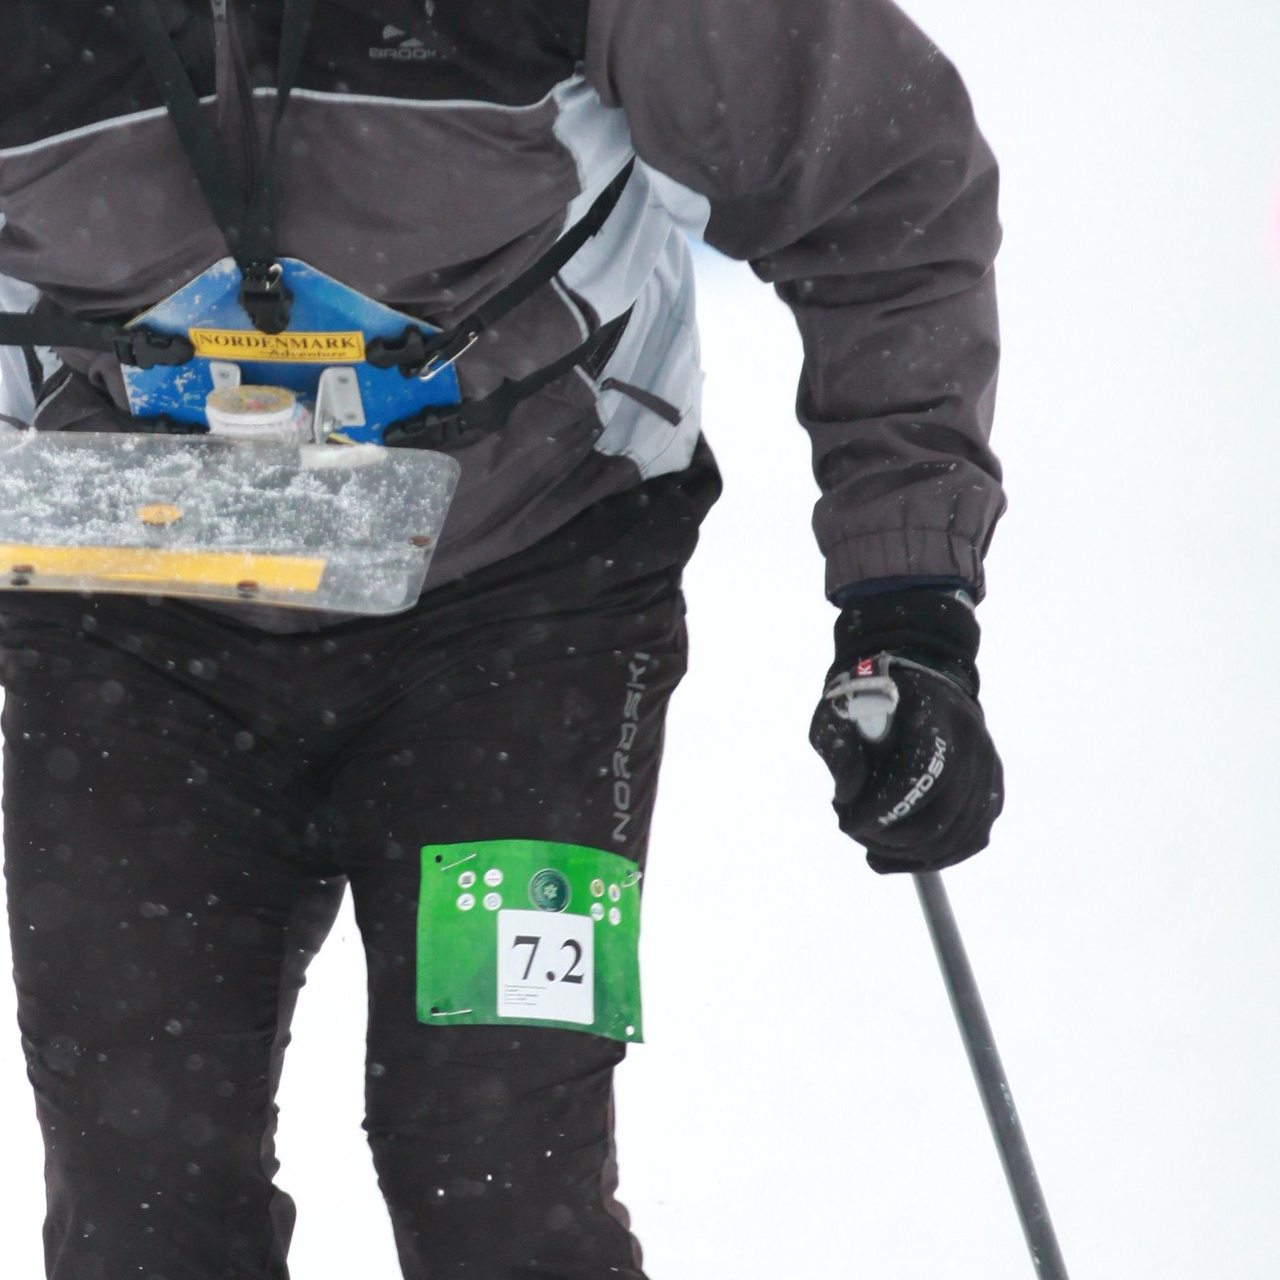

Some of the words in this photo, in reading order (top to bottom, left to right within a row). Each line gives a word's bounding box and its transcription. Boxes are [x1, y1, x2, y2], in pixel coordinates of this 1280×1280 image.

[200, 333, 356, 350] NORDENMARK
[260, 349, 346, 358] Adventure
[612, 652, 650, 842] NORDSKI
[878, 736, 947, 826] NORDSKI
[512, 935, 585, 984] 7.2
